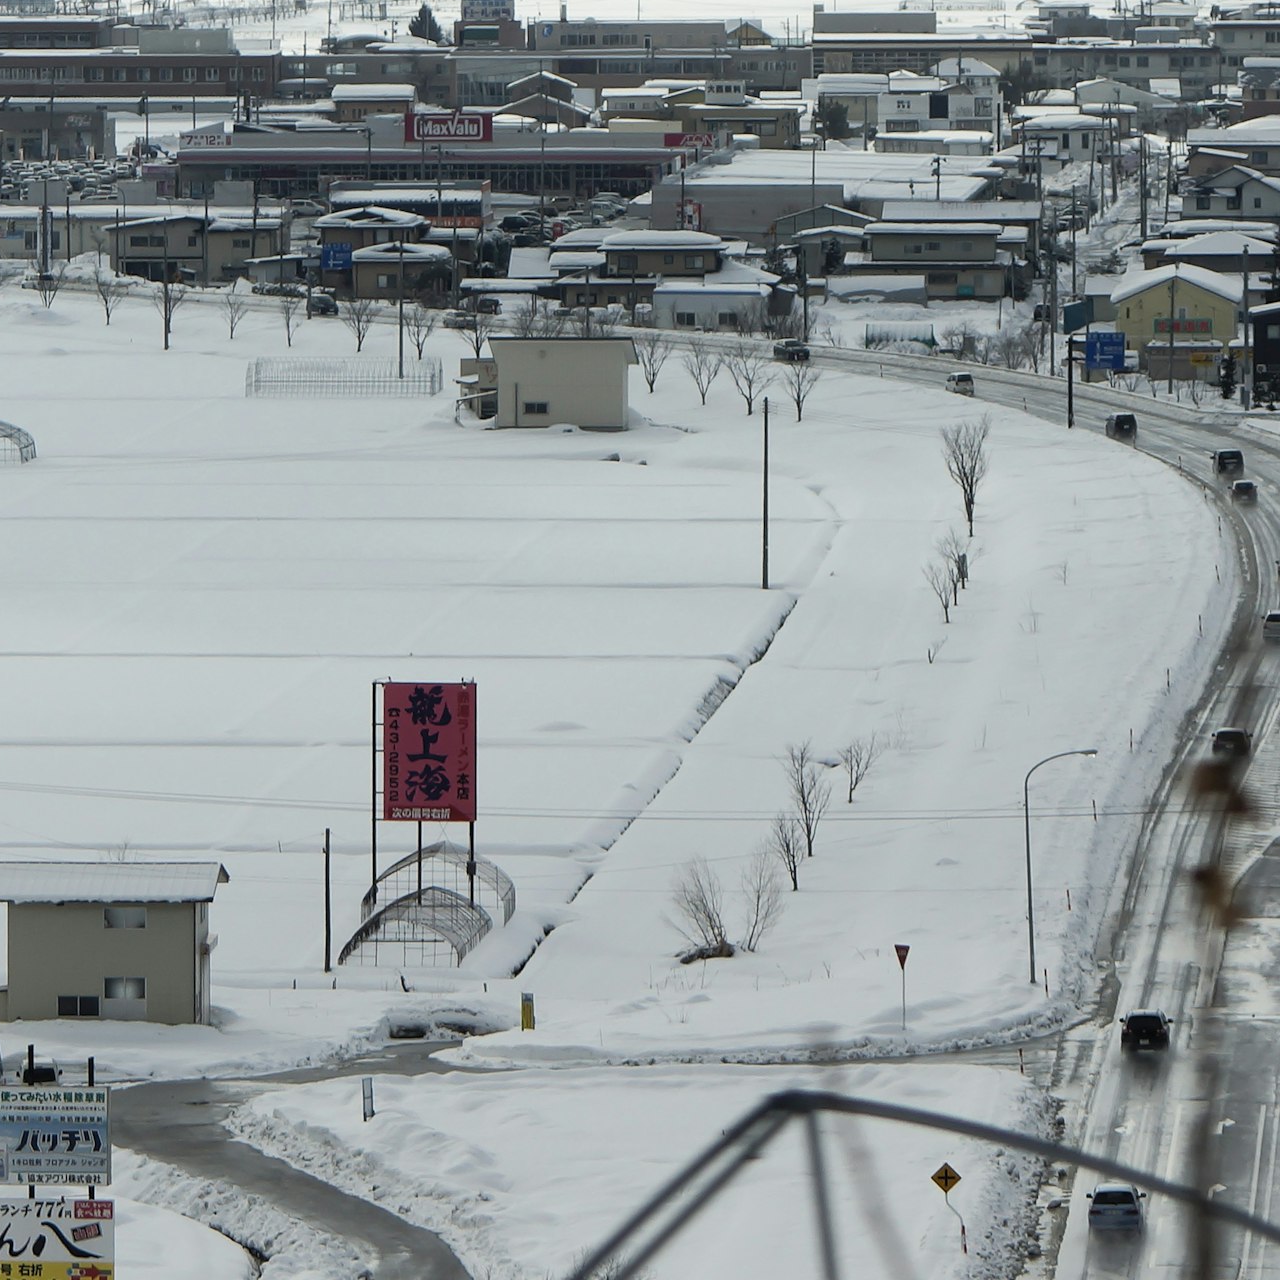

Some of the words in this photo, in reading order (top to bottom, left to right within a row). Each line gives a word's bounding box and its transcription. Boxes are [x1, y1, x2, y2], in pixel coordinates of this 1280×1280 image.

[419, 111, 478, 135] MaxValu
[404, 685, 452, 803] 龍上海
[392, 807, 452, 819] 次の信号右折
[0, 1091, 106, 1104] 使ってみたい水稲除草剤
[14, 1129, 103, 1152] バッチリ
[27, 1173, 102, 1184] 協友アグリ株式会社
[18, 1263, 43, 1277] 右折
